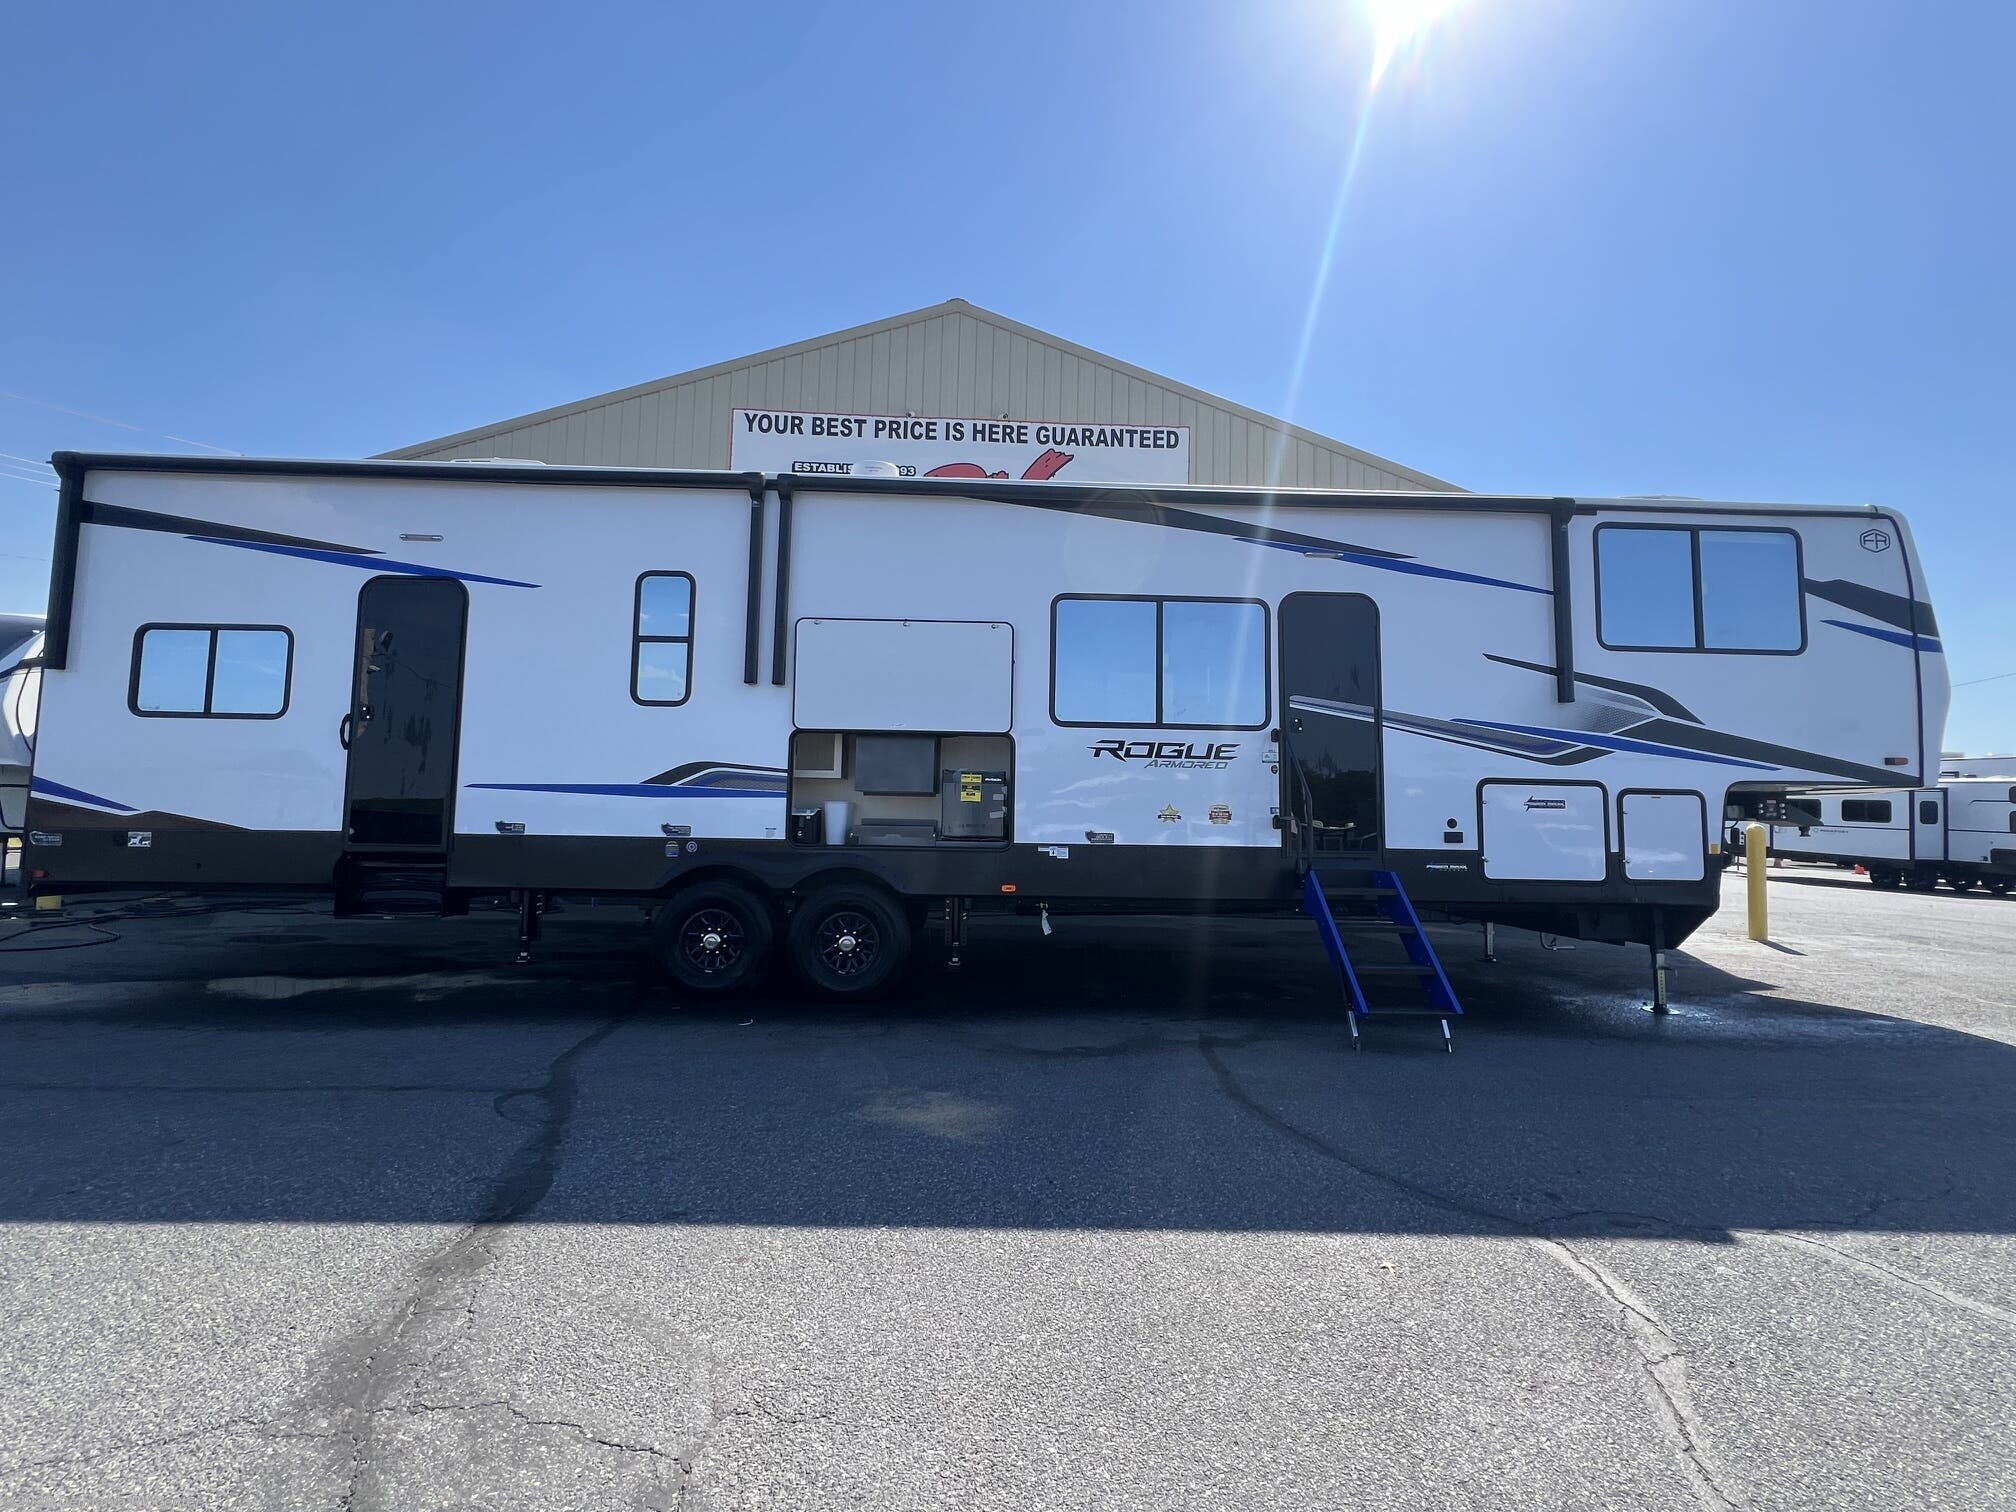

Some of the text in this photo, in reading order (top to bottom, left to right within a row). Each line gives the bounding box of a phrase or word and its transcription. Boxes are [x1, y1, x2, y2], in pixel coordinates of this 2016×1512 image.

[744, 413, 1180, 449] YOUR BEST PRICE IS HERE GUARANTEED
[794, 462, 854, 474] ESTABLIS
[1087, 739, 1241, 762] ROGUE
[1143, 759, 1229, 770] ARMORED
